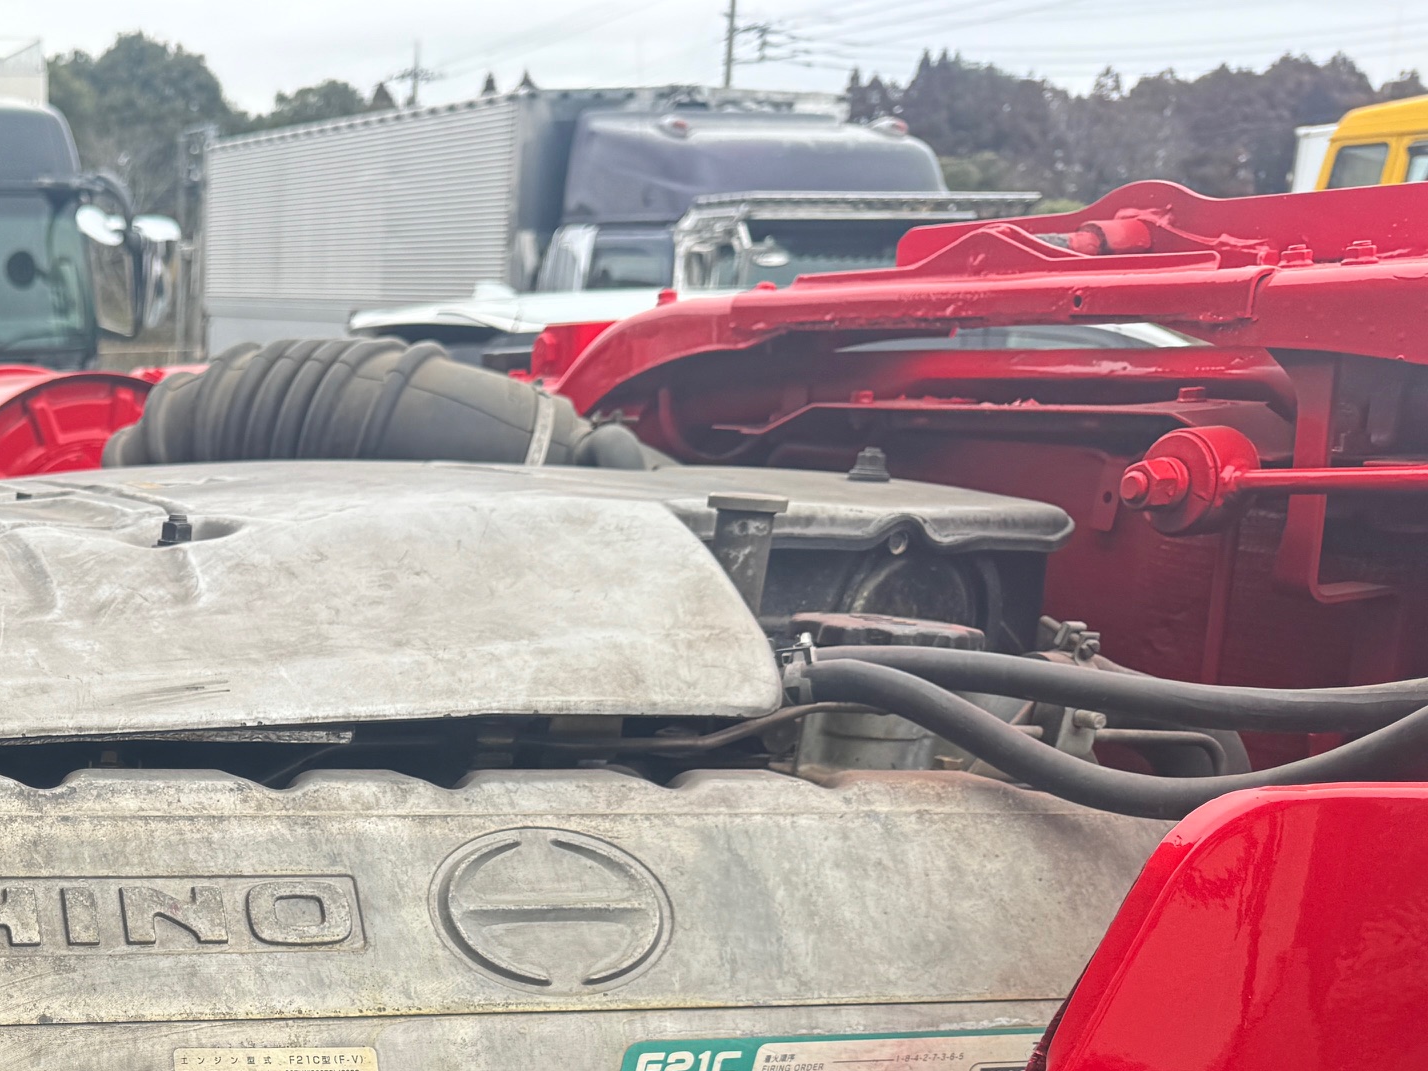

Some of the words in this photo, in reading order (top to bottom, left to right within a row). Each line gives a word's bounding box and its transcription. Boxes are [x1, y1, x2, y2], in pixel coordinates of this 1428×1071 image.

[180, 1055, 273, 1065] エンジン型式
[793, 1062, 825, 1071] ORDER
